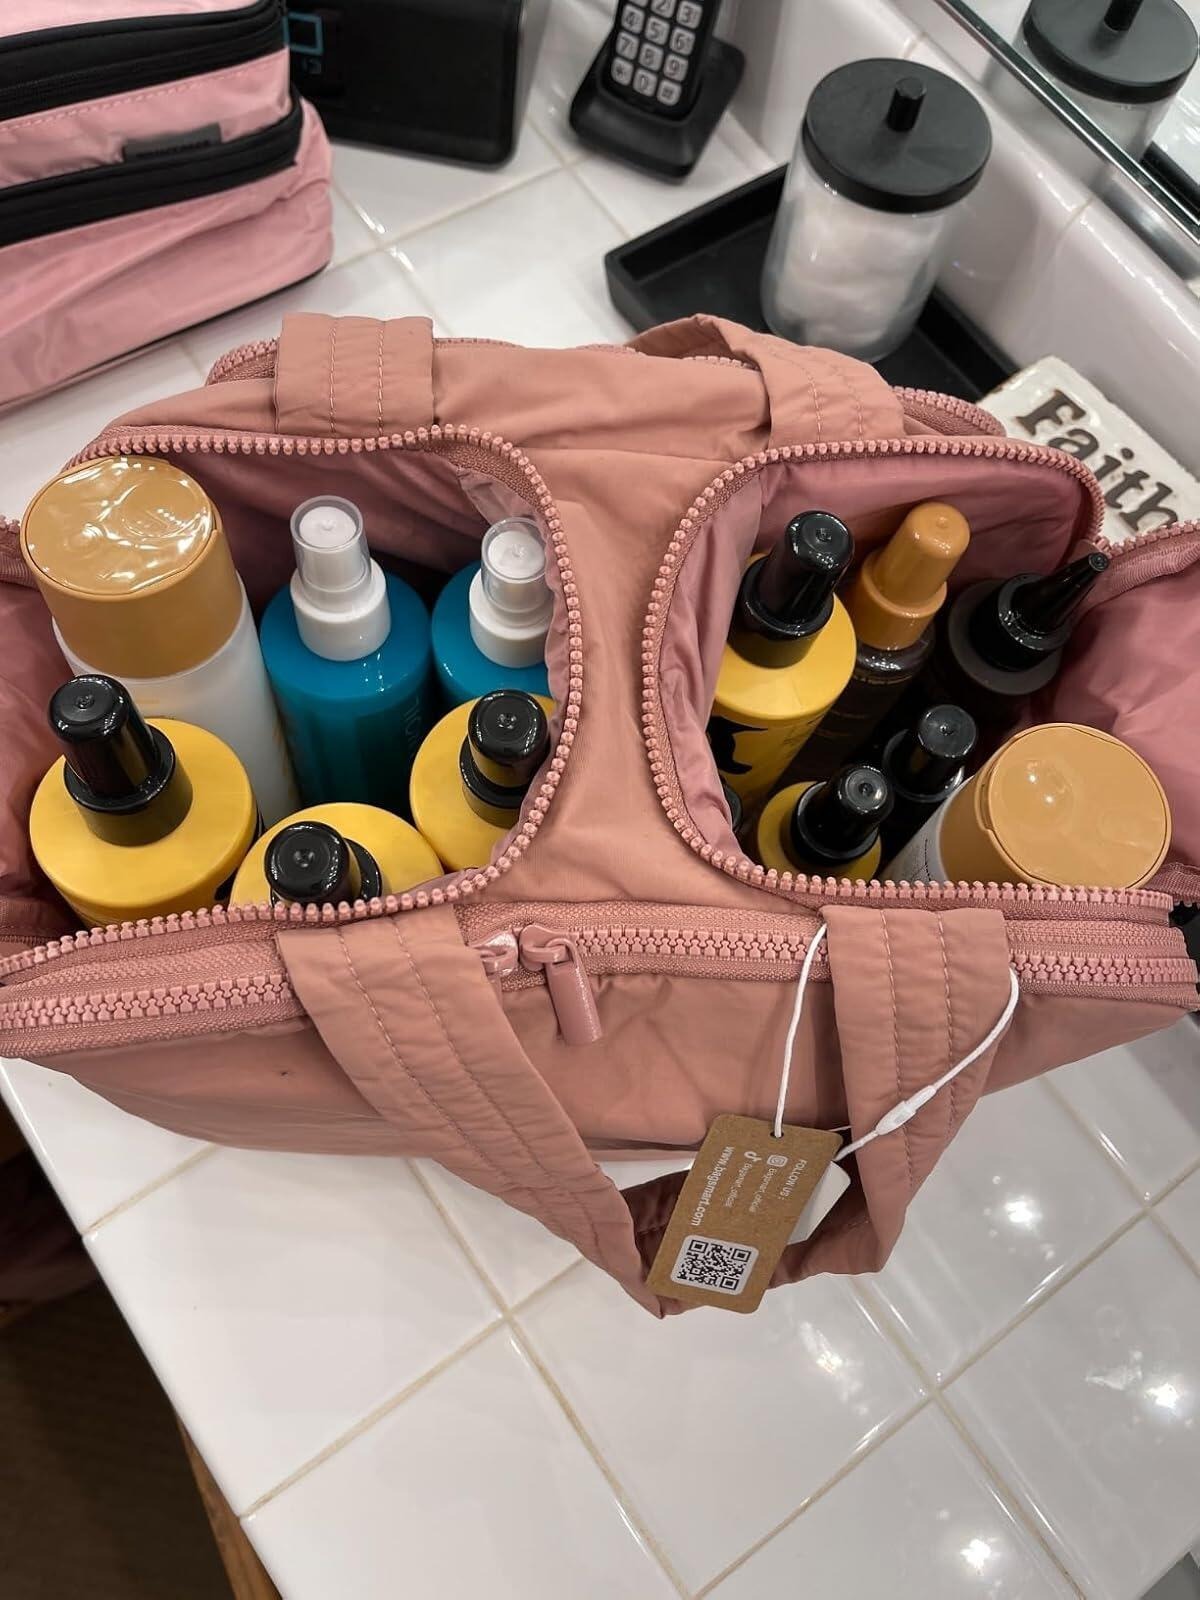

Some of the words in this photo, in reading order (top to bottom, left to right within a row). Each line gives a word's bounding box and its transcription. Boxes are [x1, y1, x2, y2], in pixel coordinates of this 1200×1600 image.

[1016, 388, 1179, 531] Faith
[690, 1146, 735, 1227] www.bagsmart.com
[786, 1159, 807, 1187] FOLLOW
